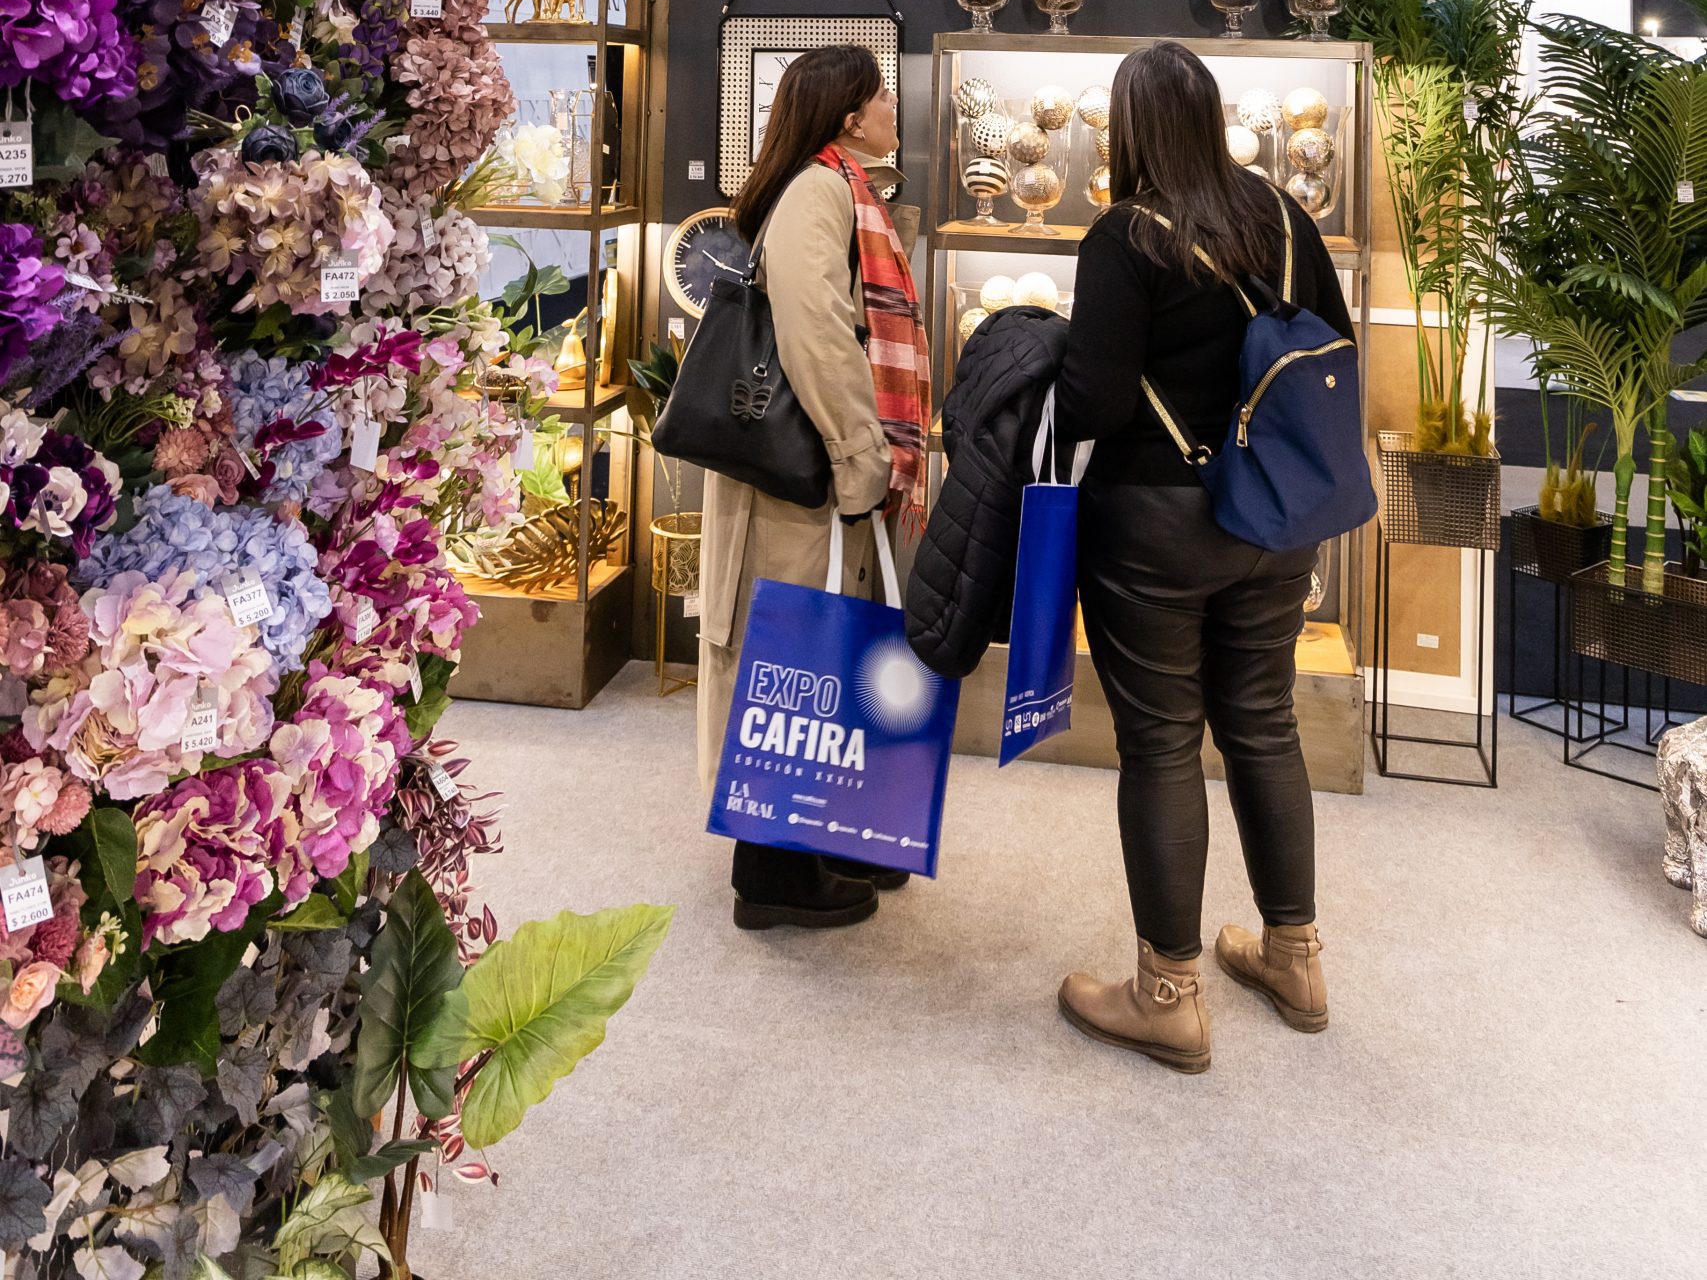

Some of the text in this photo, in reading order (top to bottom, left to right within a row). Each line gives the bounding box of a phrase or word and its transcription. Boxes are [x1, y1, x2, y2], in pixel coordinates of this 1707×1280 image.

[420, 9, 439, 17] 3.440
[325, 272, 355, 280] FA472
[325, 291, 356, 300] $ 2.050
[232, 589, 262, 606] FA377
[246, 608, 270, 622] 5.200
[747, 660, 842, 718] EXPO
[190, 714, 213, 727] A241
[192, 736, 214, 749] 5.420
[739, 706, 865, 772] CAFIRA
[734, 753, 864, 790] EDICIÓN XXXIV
[728, 780, 750, 798] LA
[726, 795, 777, 820] RURAL
[8, 884, 44, 904] FA474
[20, 908, 48, 924] 2.600
